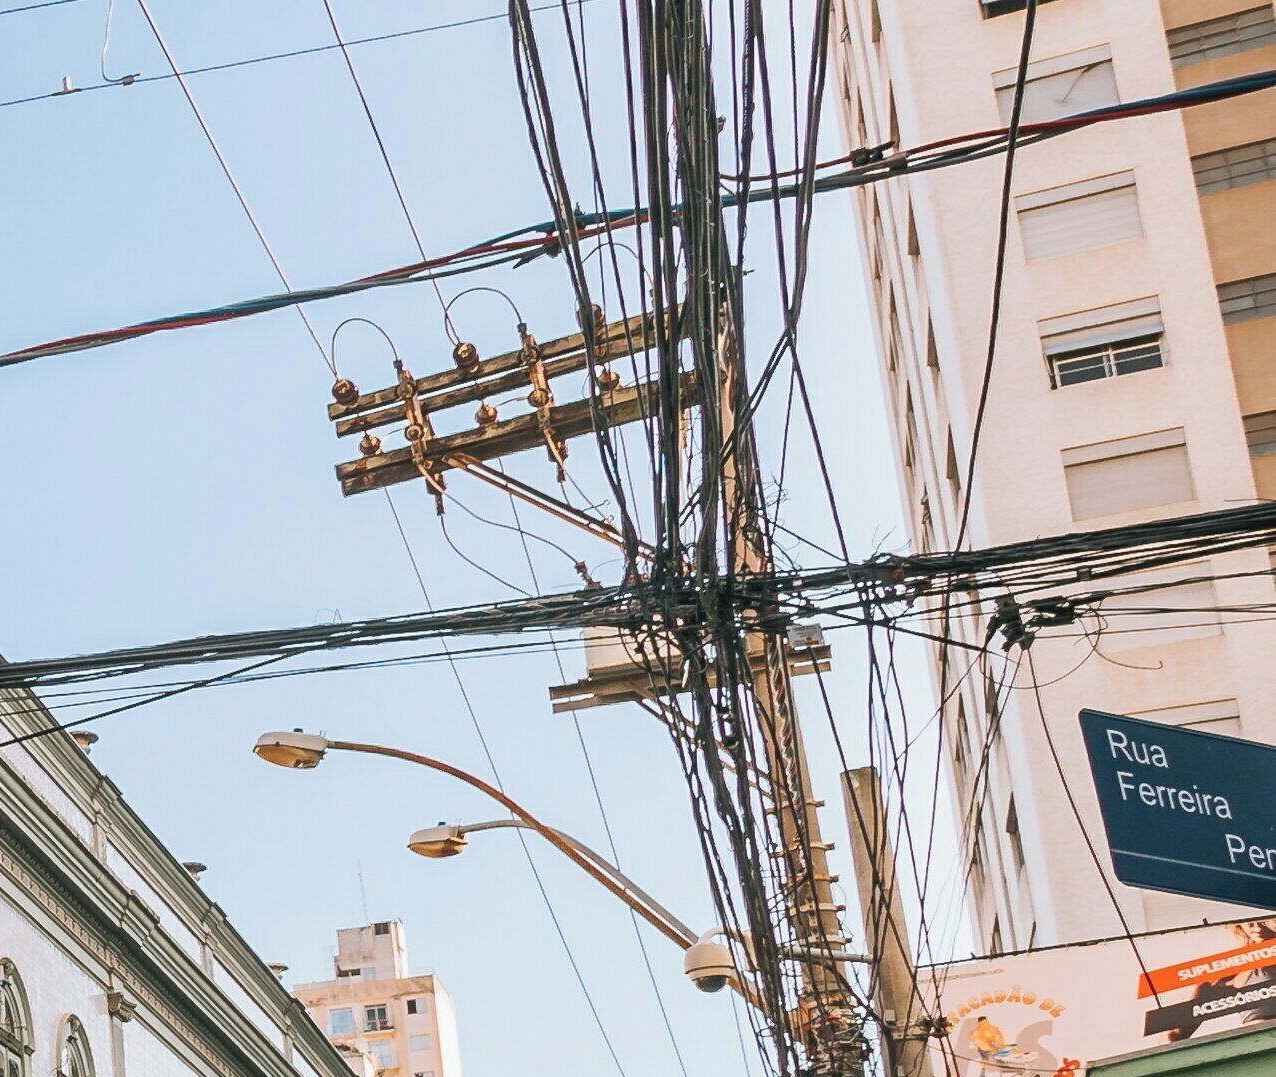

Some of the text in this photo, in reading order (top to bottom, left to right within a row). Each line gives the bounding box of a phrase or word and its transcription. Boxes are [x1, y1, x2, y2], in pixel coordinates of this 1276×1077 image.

[1106, 729, 1169, 768] Rua
[1117, 770, 1233, 820] Ferreira
[1177, 945, 1276, 981] SUPLEMENTOS
[1039, 998, 1066, 1018] DE
[1192, 985, 1276, 1017] ACESSÓRIOS
